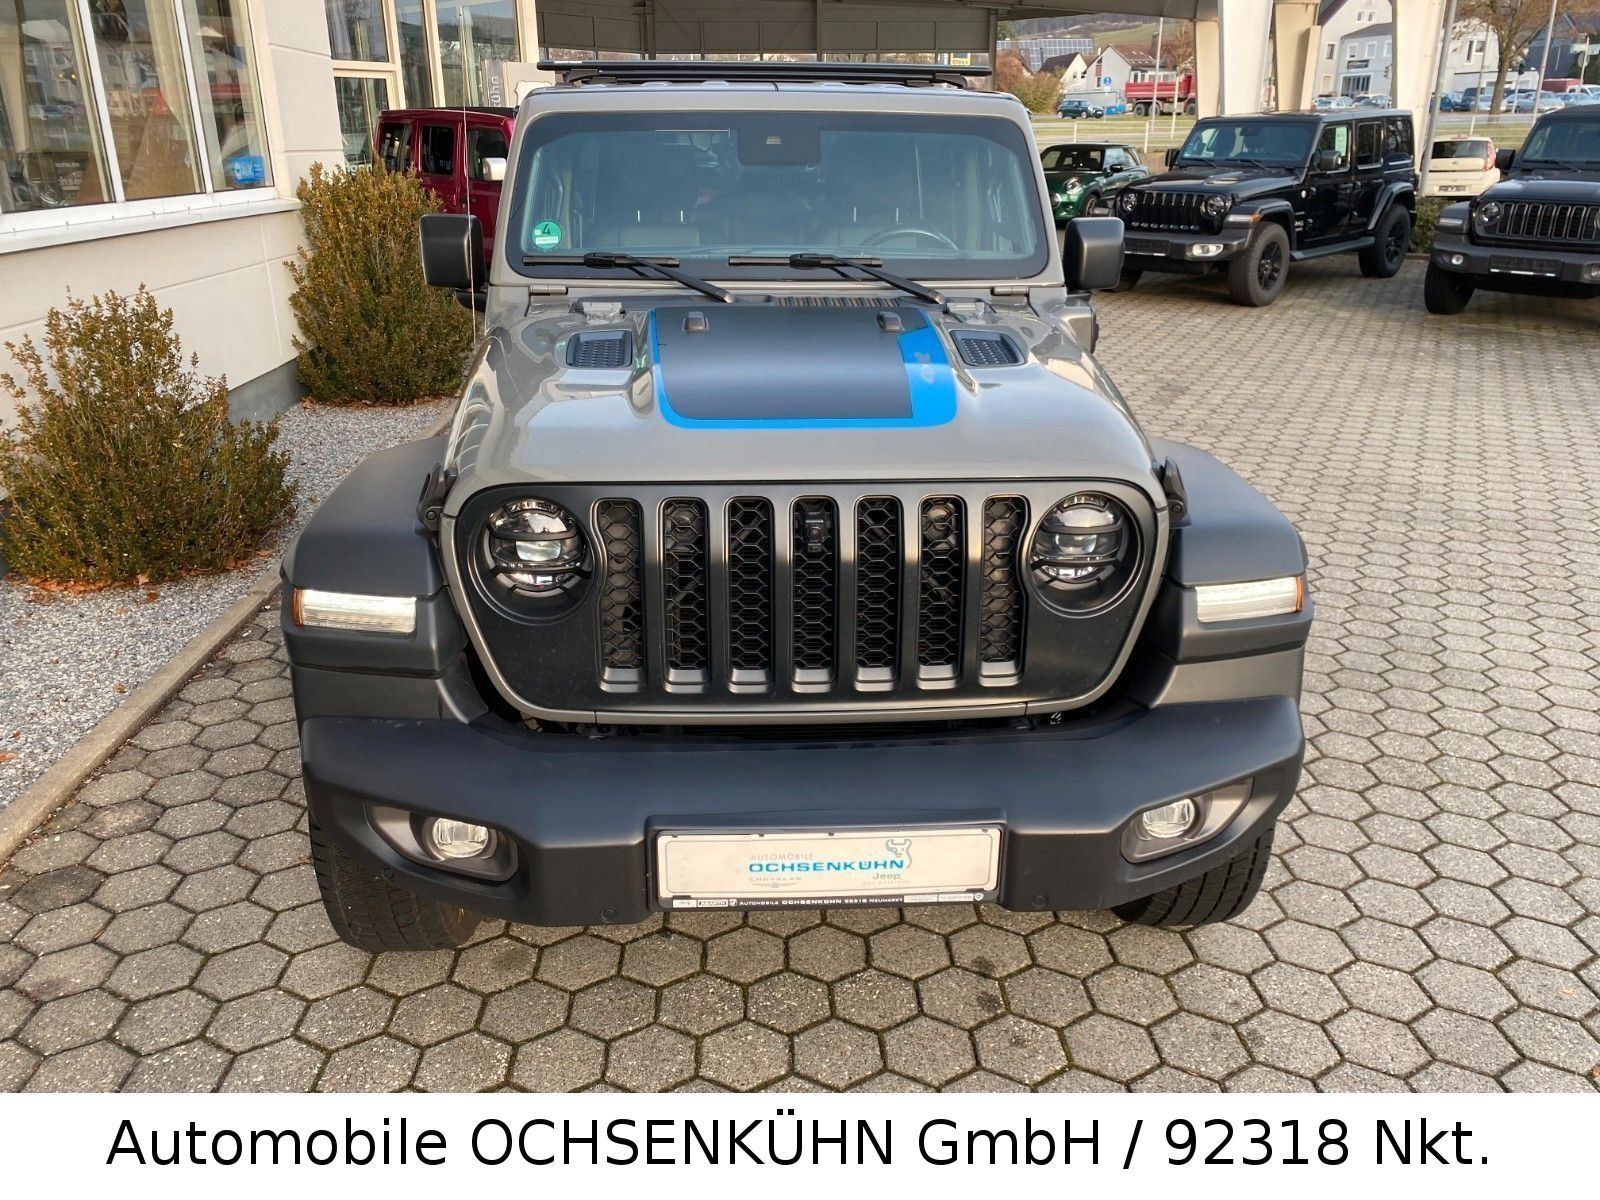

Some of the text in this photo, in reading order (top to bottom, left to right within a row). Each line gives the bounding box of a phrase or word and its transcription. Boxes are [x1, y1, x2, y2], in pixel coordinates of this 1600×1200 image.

[542, 223, 551, 235] 4
[750, 853, 814, 861] AUTOMOBILE
[749, 859, 904, 873] OCHSENKÜHN
[872, 872, 901, 881] Jeep
